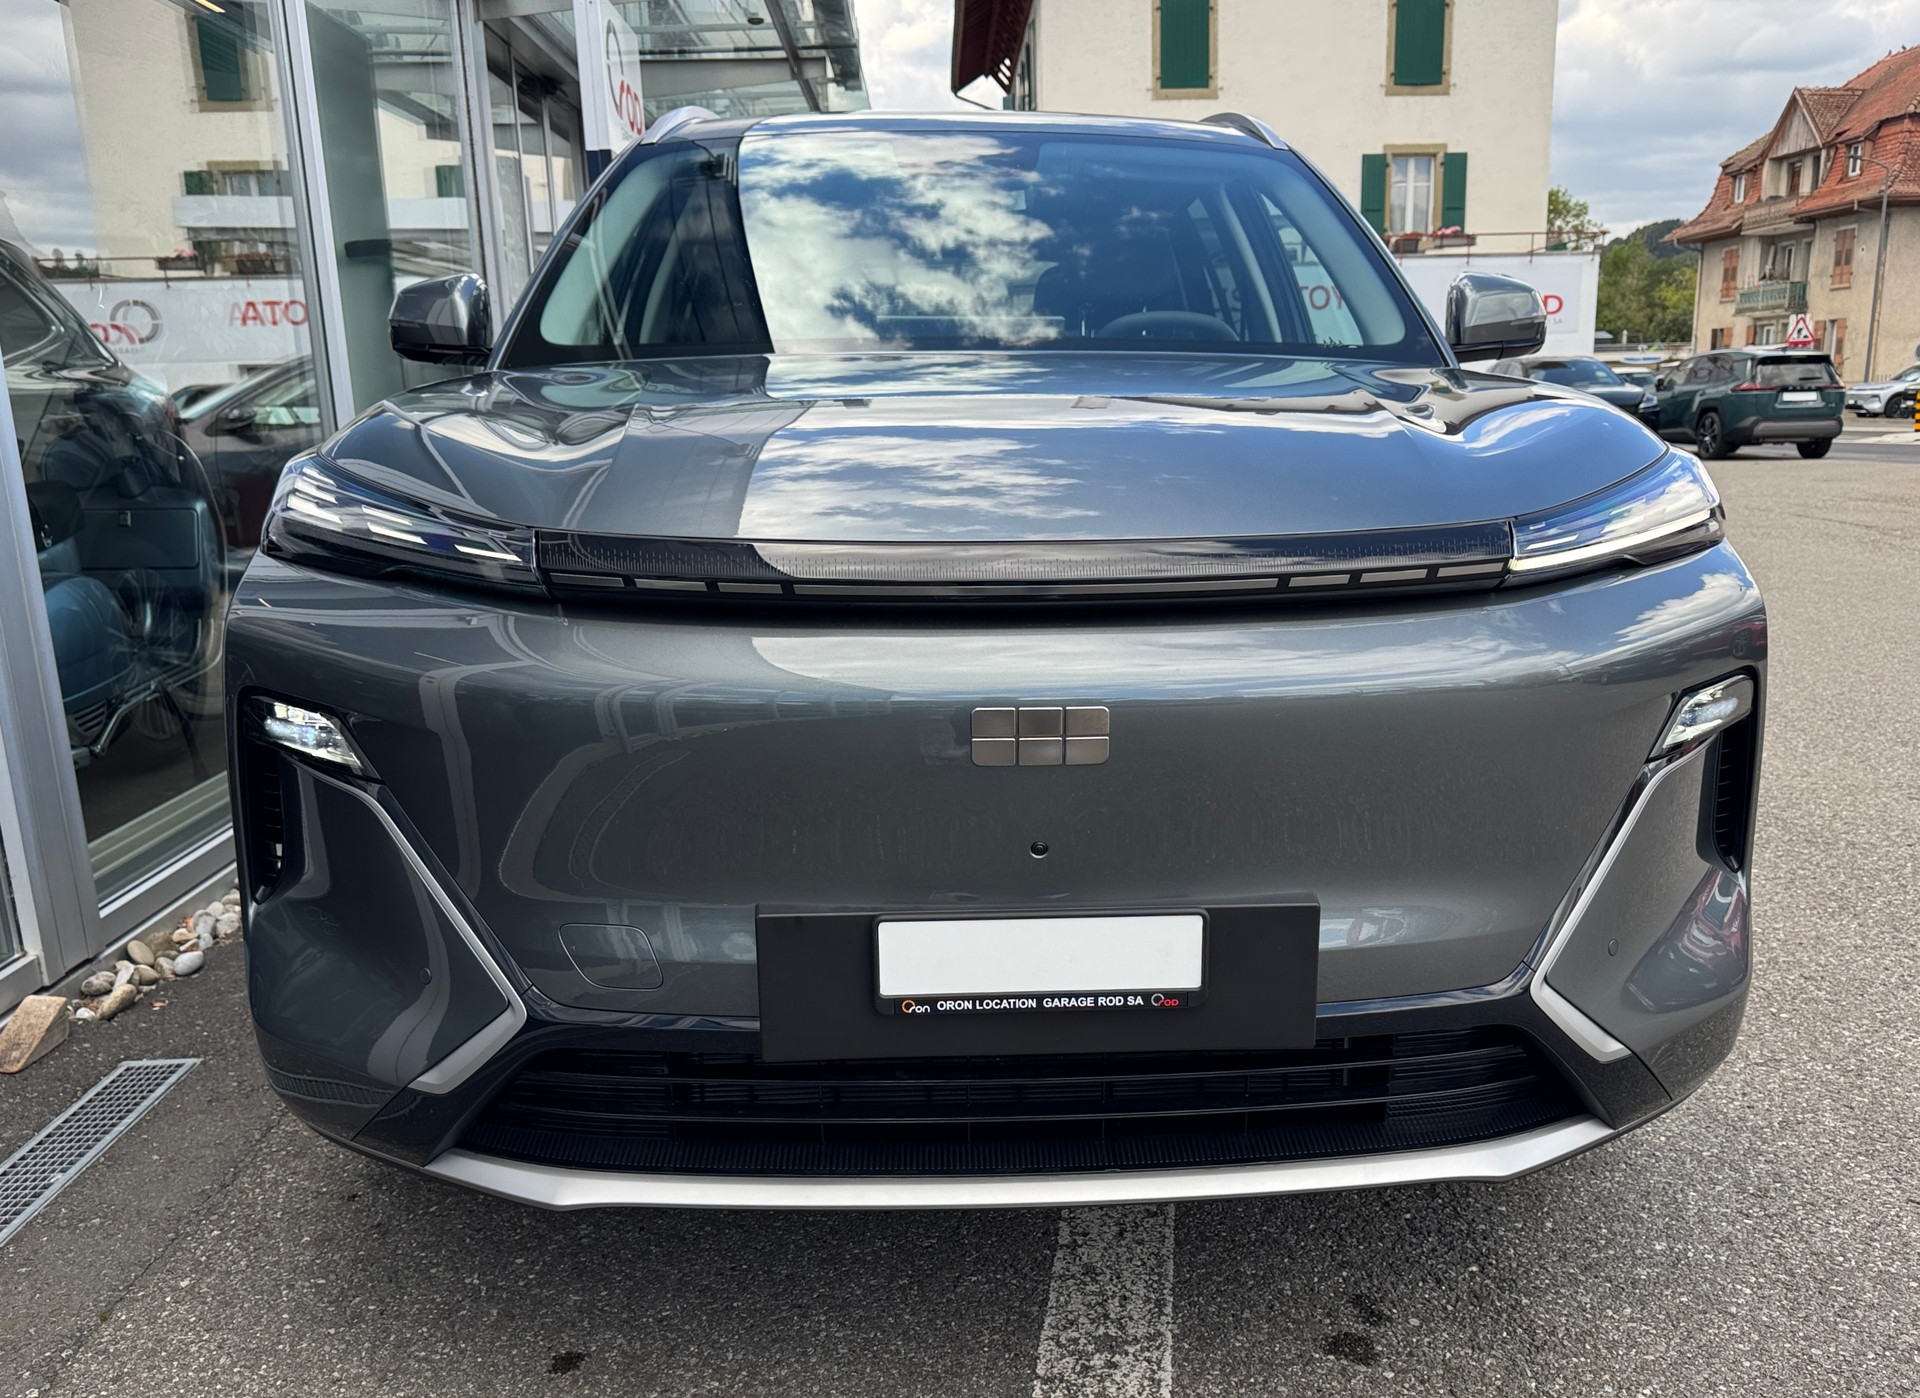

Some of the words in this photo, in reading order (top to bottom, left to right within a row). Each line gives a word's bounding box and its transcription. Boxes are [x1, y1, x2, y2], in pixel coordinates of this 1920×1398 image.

[936, 1000, 973, 1010] ORON
[975, 998, 1037, 1010] LOCATION
[1042, 996, 1095, 1008] GARAGE
[1097, 996, 1125, 1007] ROD
[1126, 995, 1144, 1006] SA
